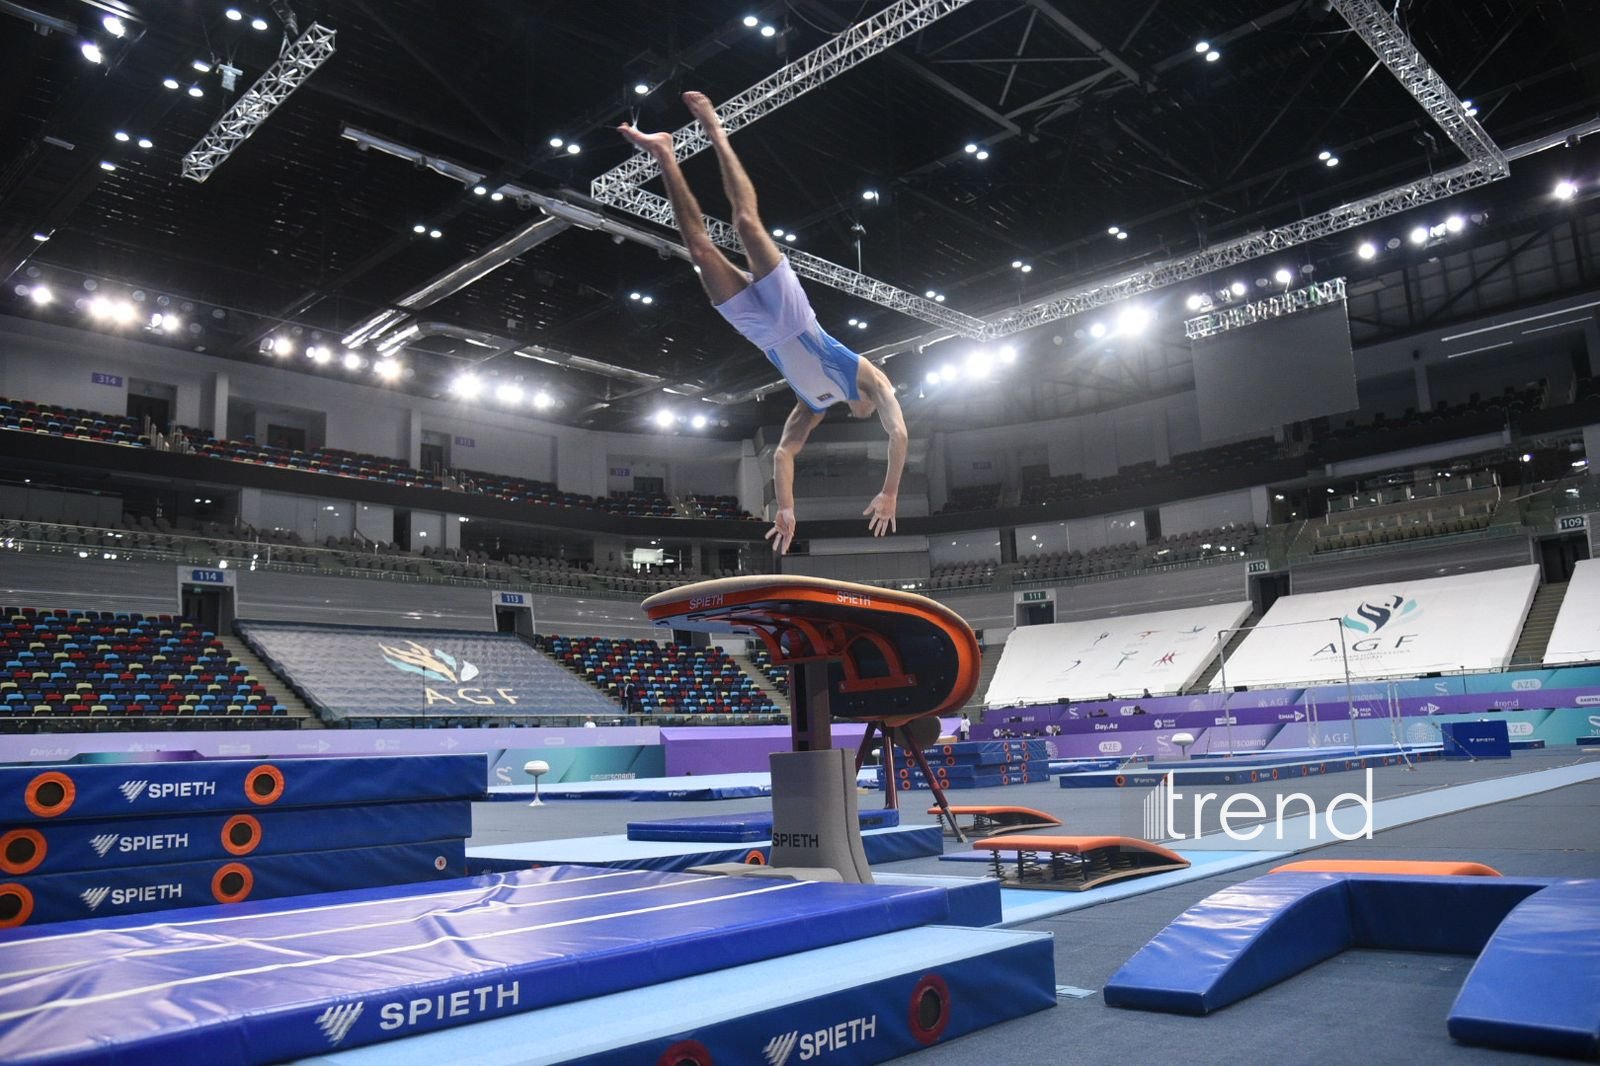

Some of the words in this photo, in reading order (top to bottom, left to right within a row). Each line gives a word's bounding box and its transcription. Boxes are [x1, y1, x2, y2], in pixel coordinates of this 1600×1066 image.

[98, 374, 117, 385] 314
[1562, 518, 1582, 529] 109
[1250, 562, 1265, 571] 110
[199, 572, 217, 581] 114
[506, 594, 519, 603] 113
[689, 594, 724, 610] SPIETH
[836, 591, 872, 606] SPIETH
[1028, 592, 1042, 600] 111
[1313, 634, 1419, 656] AGF
[425, 686, 520, 705] AGF
[1095, 723, 1118, 731] Day.Az
[1323, 733, 1350, 743] AGF
[149, 781, 216, 798] SPIETH
[119, 833, 189, 852] SPIETH
[772, 832, 819, 849] SPIETH
[111, 883, 182, 905] SPIETH
[379, 981, 520, 1031] SPIETH
[798, 1015, 877, 1060] SPIETH
